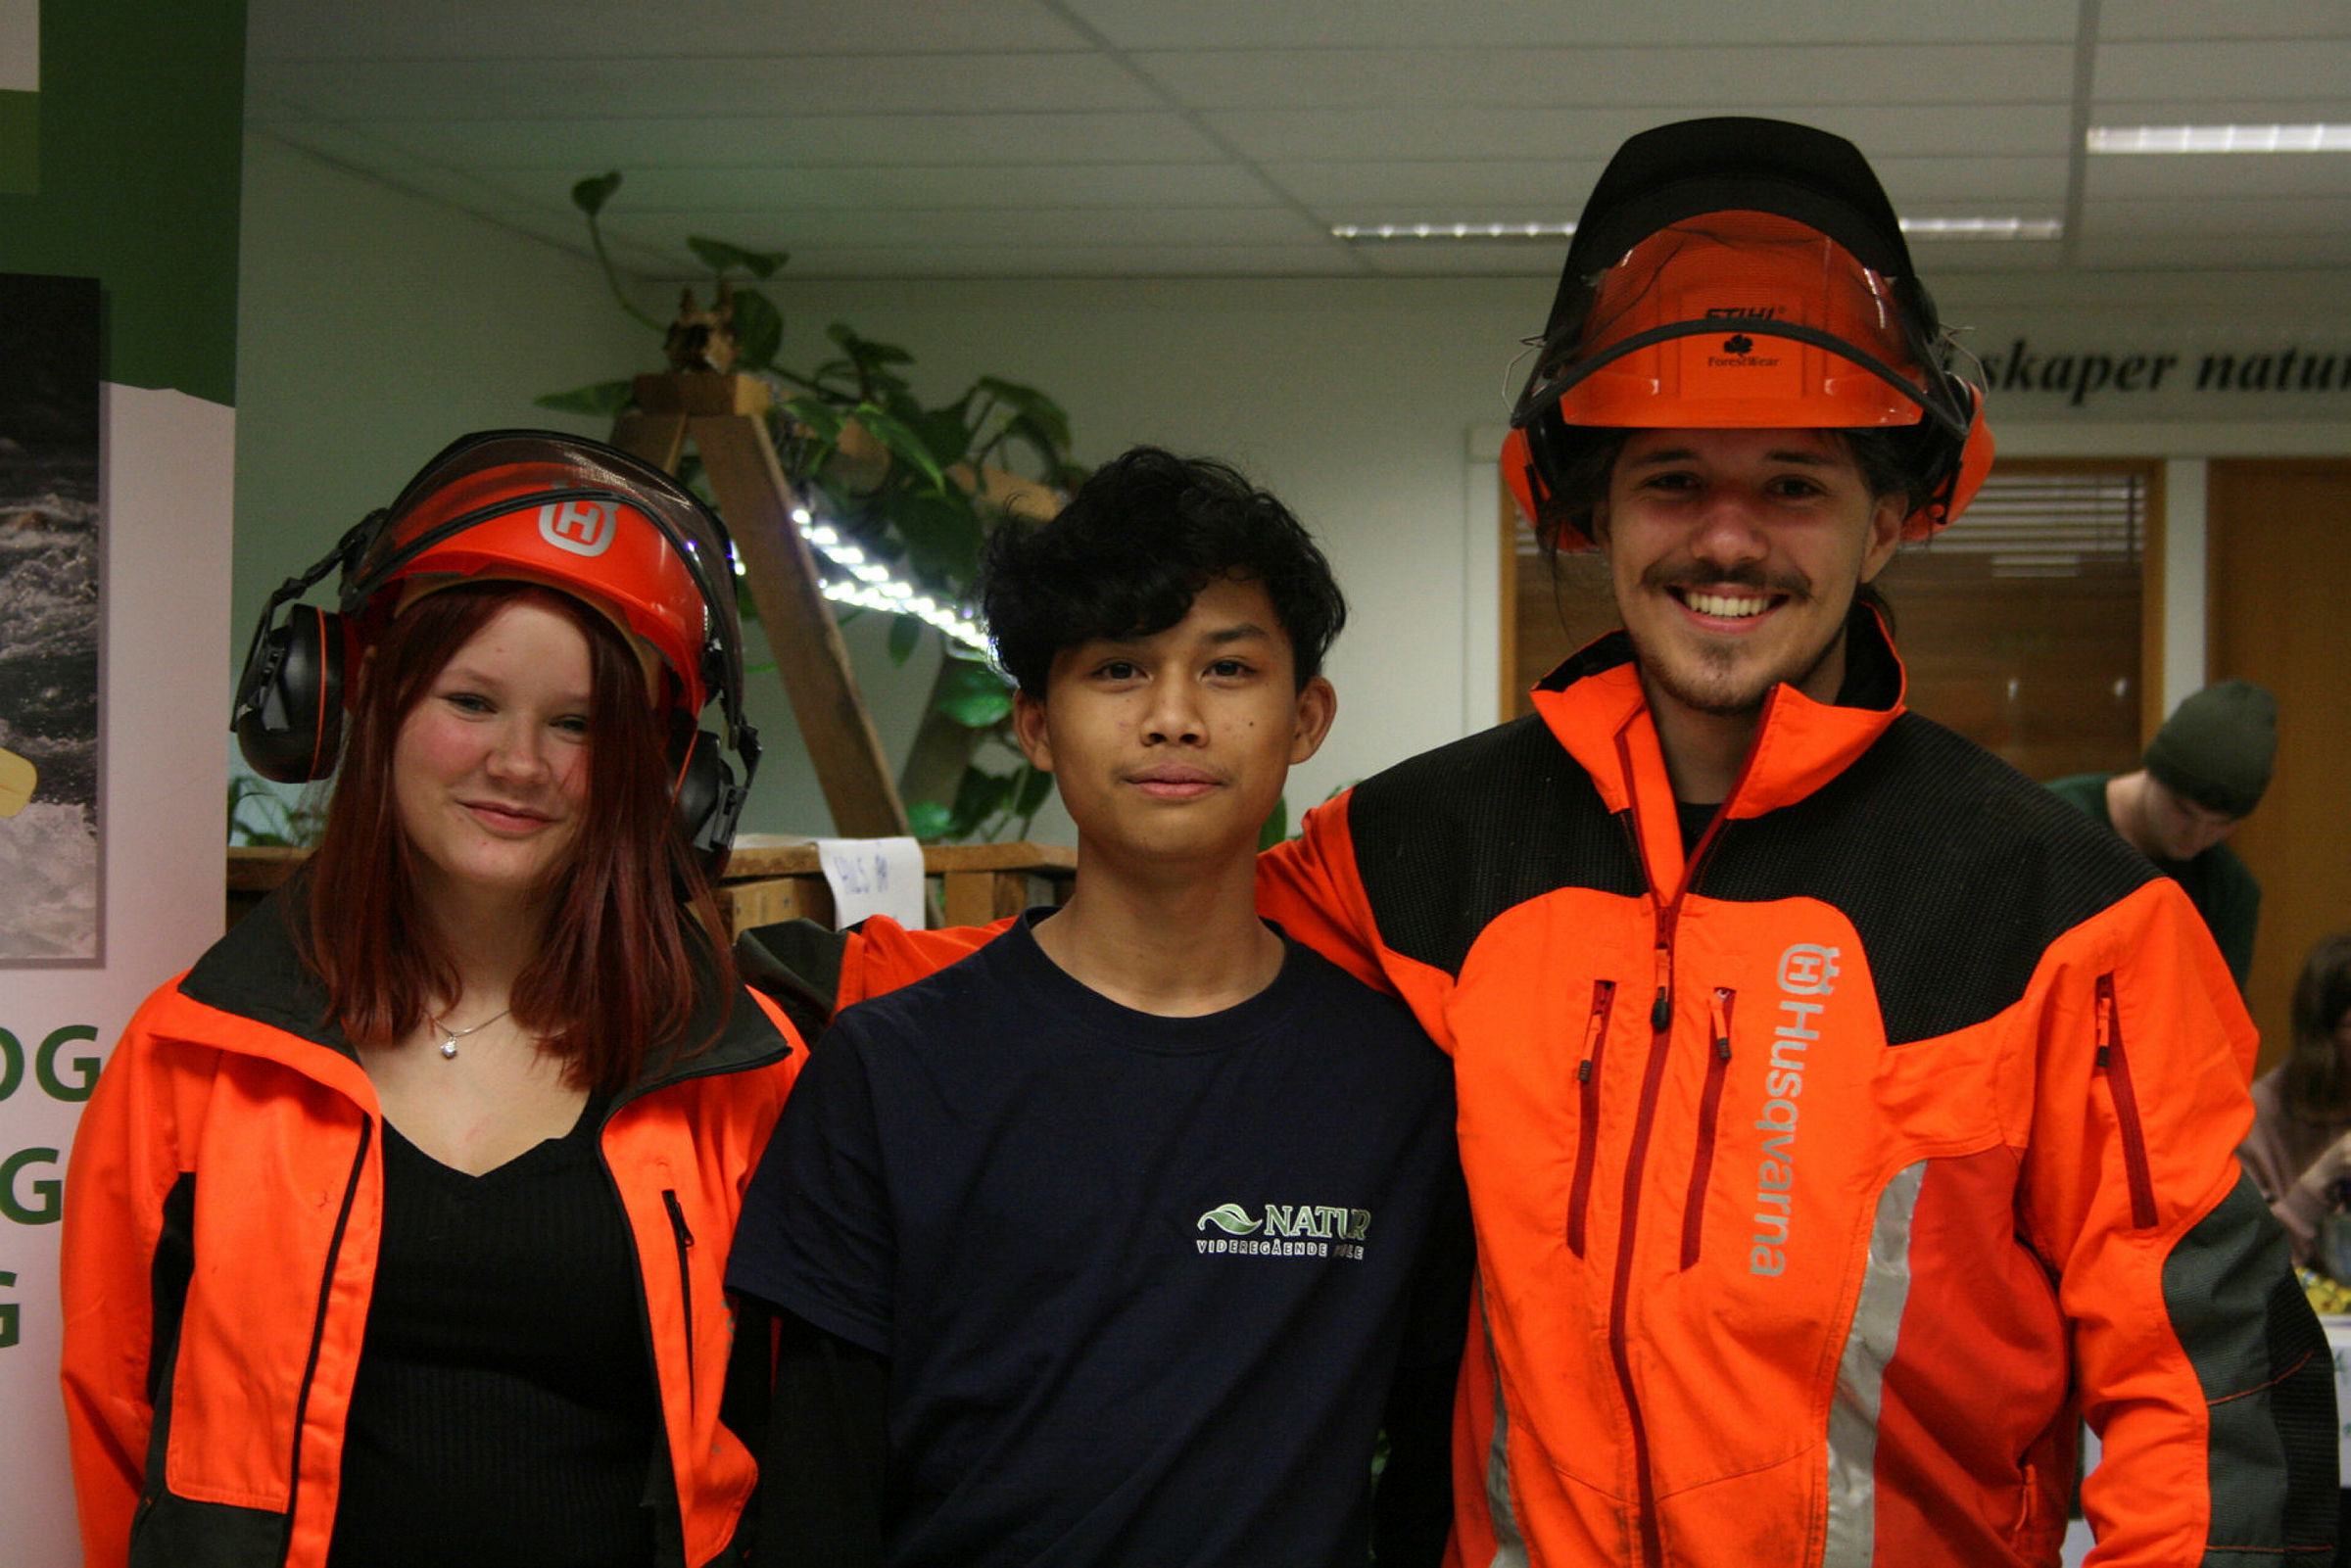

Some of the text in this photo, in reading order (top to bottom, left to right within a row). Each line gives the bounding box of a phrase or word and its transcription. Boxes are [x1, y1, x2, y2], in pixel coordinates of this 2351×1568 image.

[1980, 339, 2179, 406] skaper
[1749, 1000, 1825, 1277] Husqvarna
[1196, 1238, 1328, 1259] VIDEREGÅENDE
